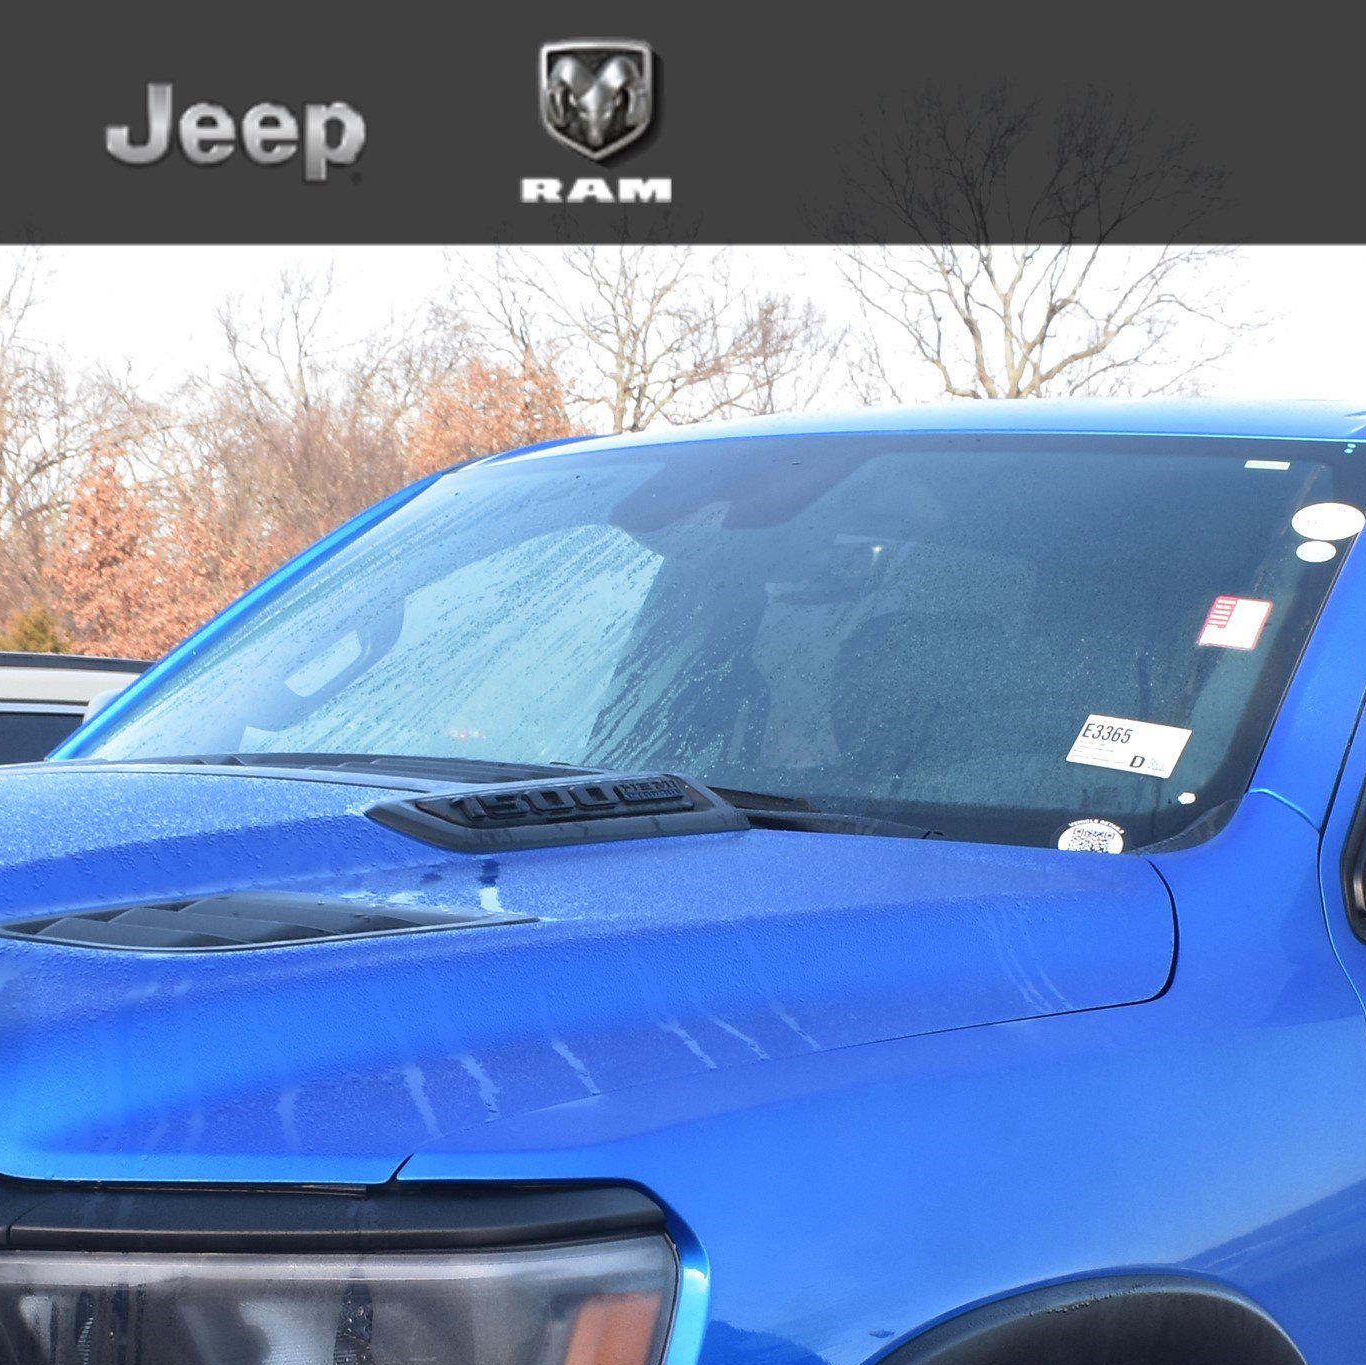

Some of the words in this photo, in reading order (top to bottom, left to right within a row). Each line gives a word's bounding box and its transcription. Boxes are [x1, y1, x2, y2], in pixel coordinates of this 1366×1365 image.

[1081, 722, 1133, 744] E3365
[1129, 754, 1146, 769] D
[450, 786, 618, 821] 1500
